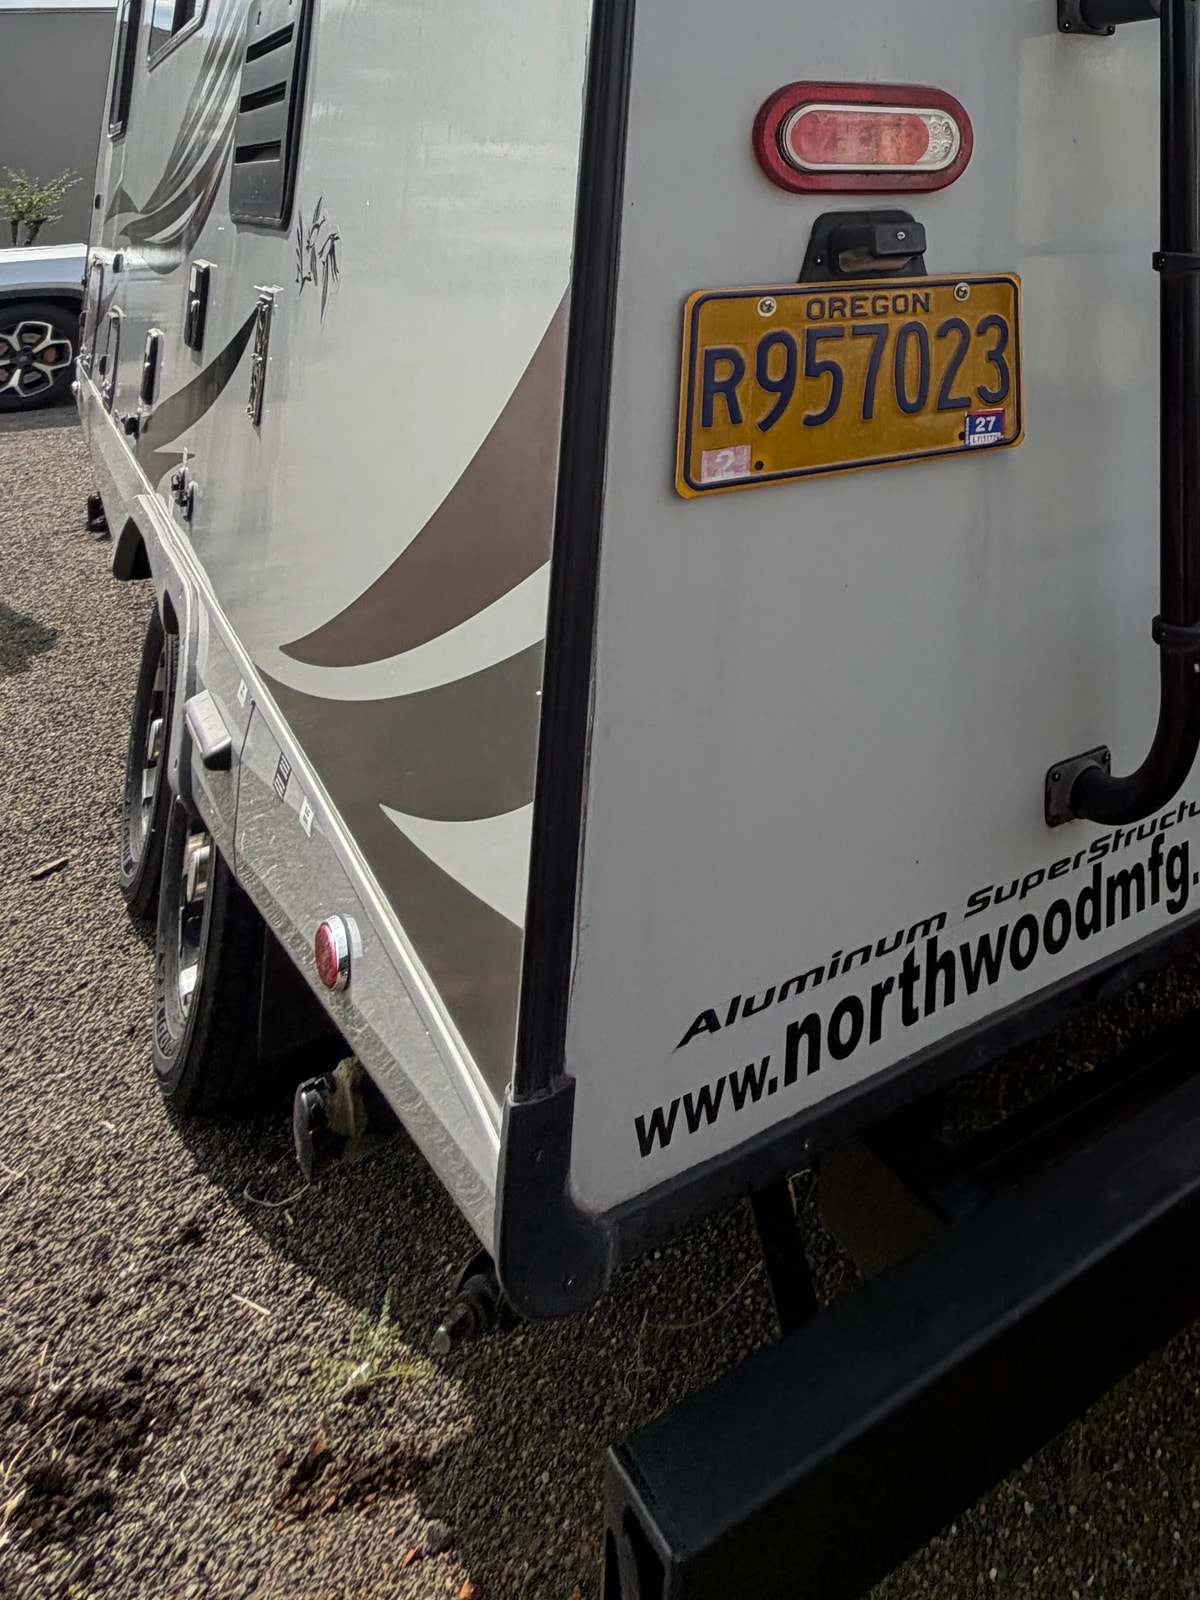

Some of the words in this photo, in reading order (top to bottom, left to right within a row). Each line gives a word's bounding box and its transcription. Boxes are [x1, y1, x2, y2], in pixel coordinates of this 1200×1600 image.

[806, 293, 931, 321] OREGON
[701, 314, 1010, 433] R957023
[975, 416, 996, 432] 27
[673, 911, 947, 1052] Aluminum
